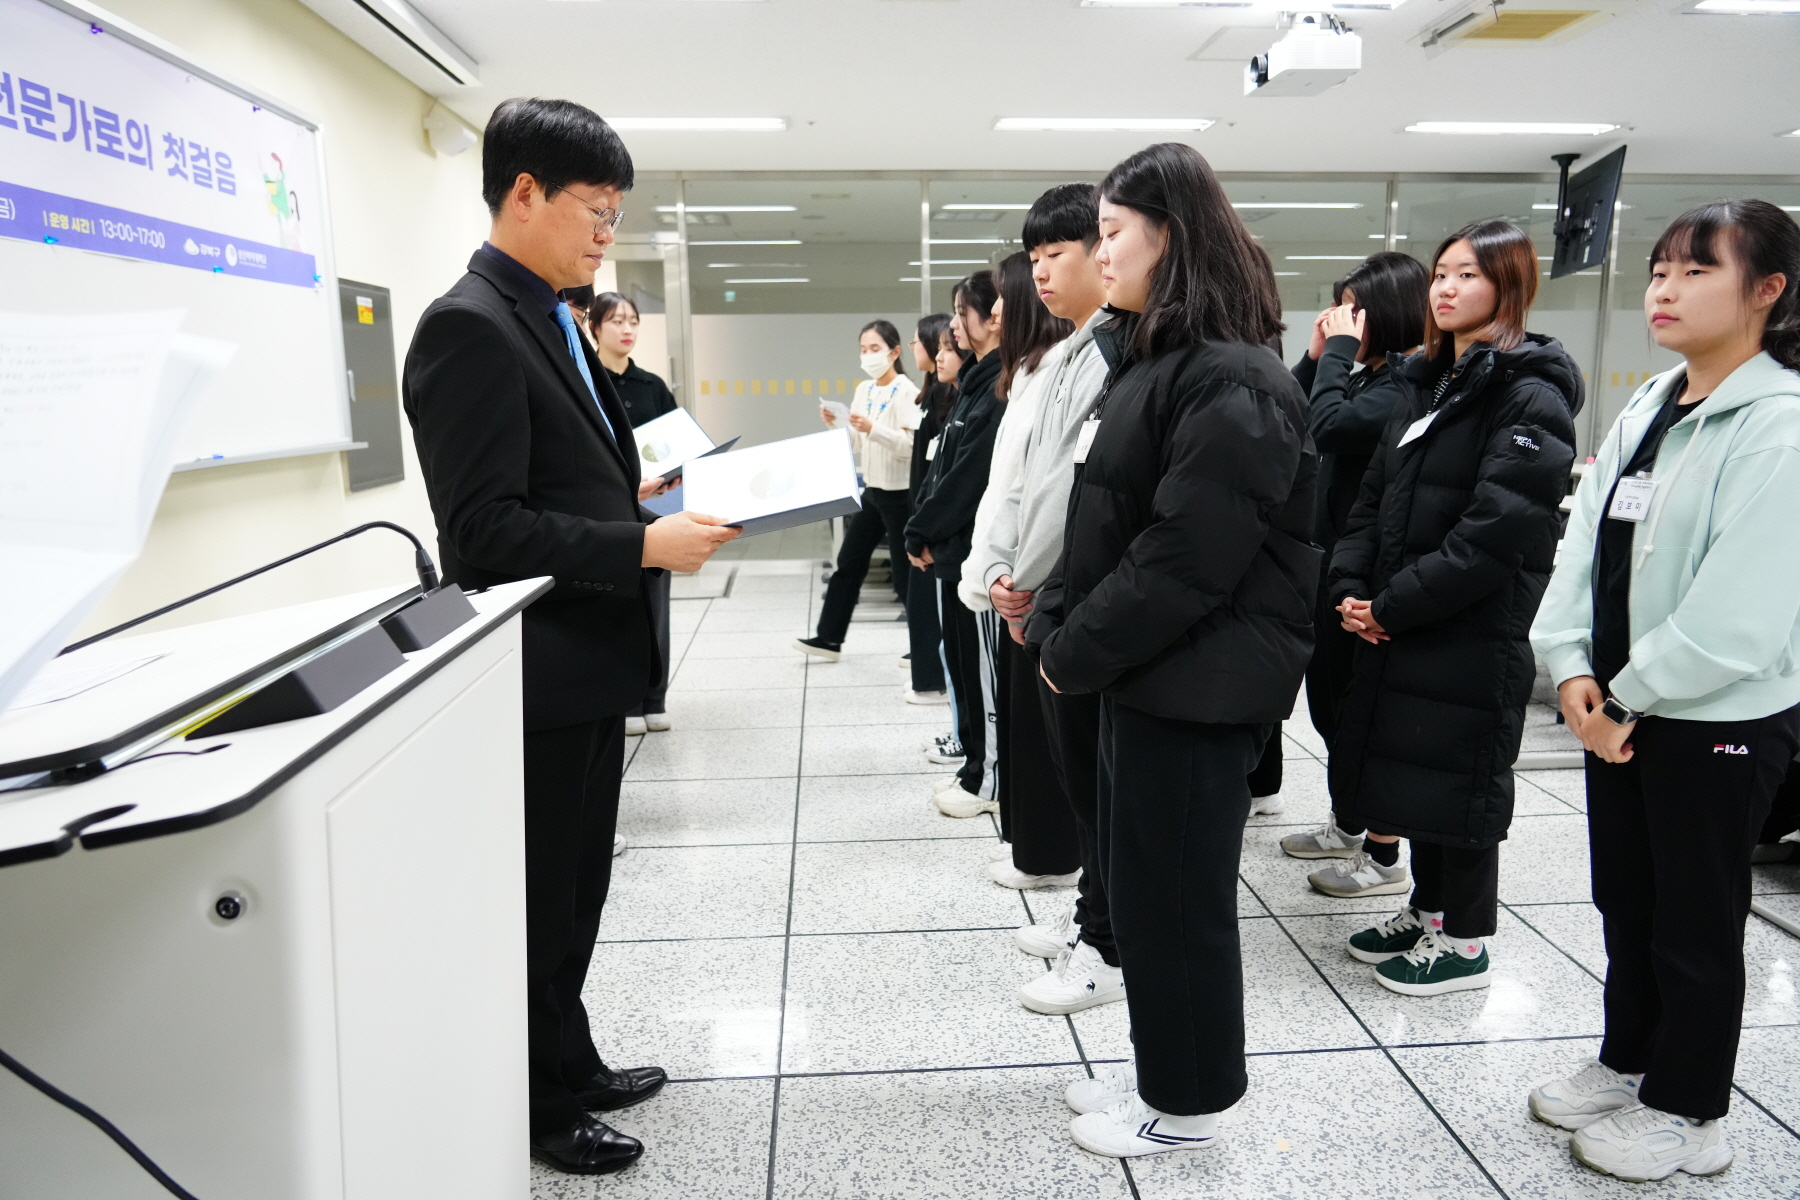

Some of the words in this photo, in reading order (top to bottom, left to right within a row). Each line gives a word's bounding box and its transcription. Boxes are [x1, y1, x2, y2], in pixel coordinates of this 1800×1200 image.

[162, 132, 236, 196] 첫걸음
[49, 212, 69, 230] 운영
[71, 217, 90, 234] 시간
[1713, 744, 1749, 754] FILA
